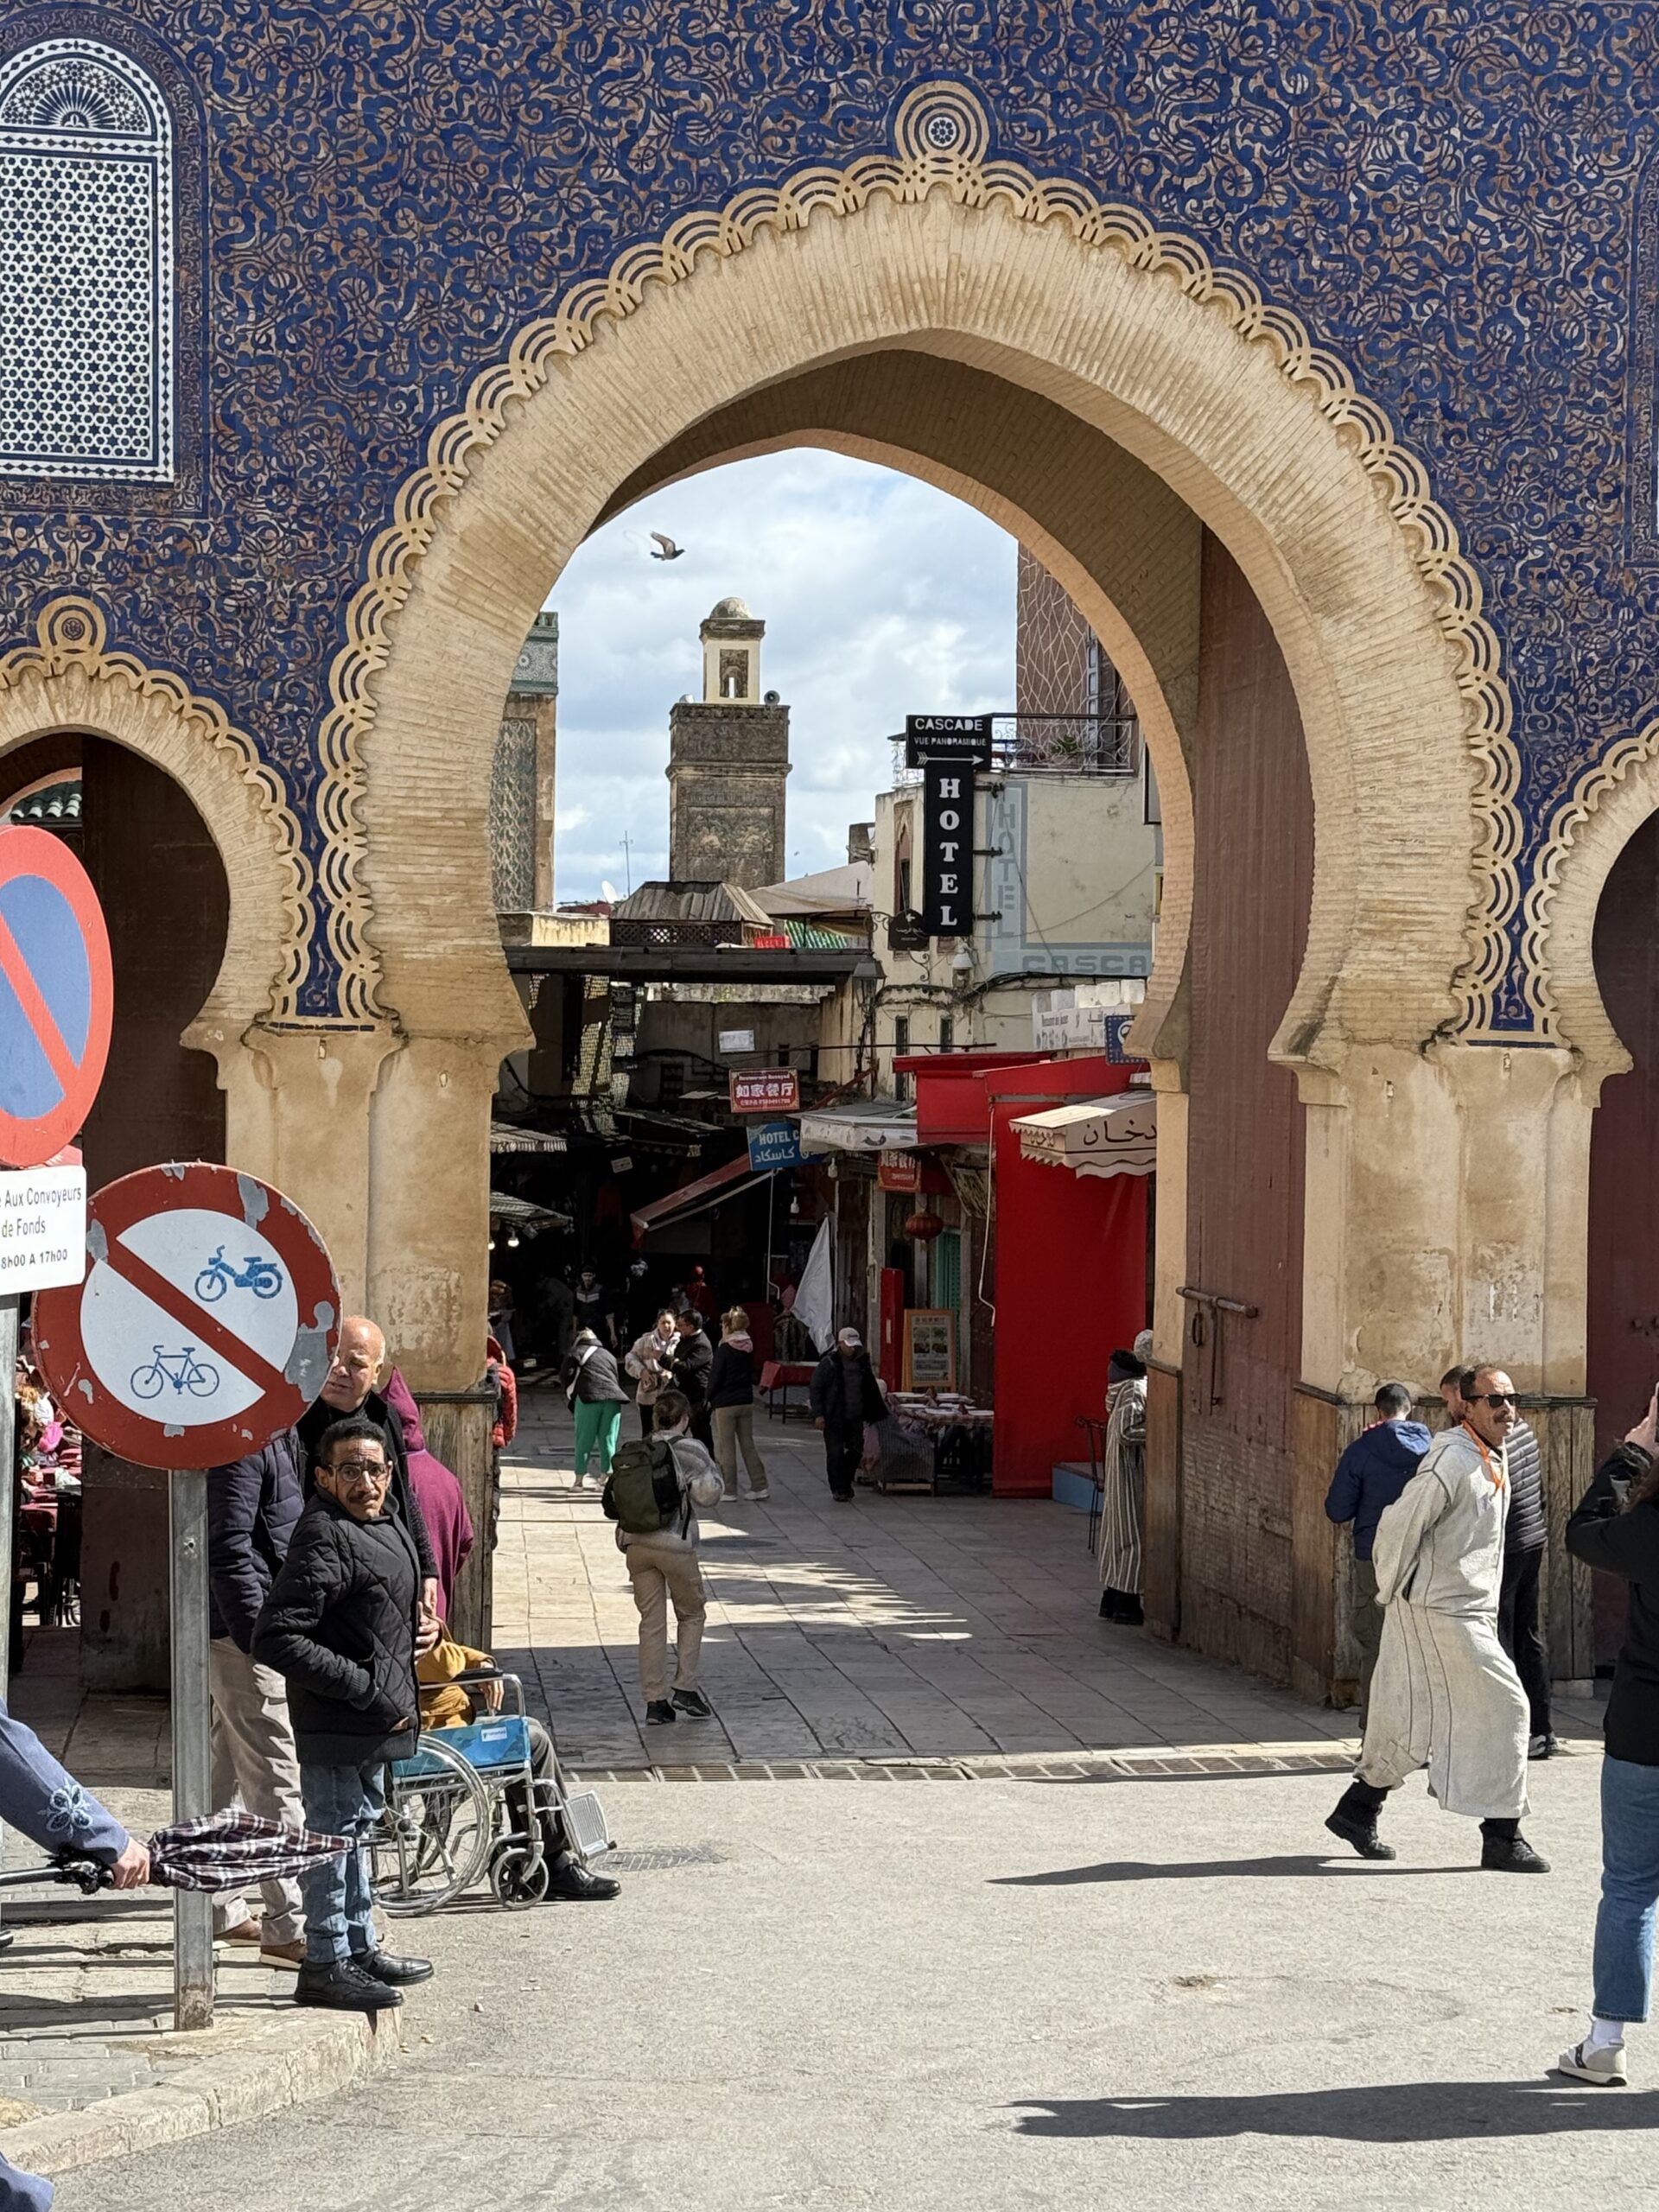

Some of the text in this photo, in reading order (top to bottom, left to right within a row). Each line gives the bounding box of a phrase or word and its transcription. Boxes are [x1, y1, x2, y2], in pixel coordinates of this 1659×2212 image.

[914, 717, 983, 732] CASCADE
[913, 736, 987, 747] VUE PANORAMIQUE
[938, 778, 961, 926] HOTEL
[997, 803, 1017, 938] HOTEL
[760, 1130, 791, 1146] HOTEL
[754, 1145, 795, 1163] كاسكاد
[4, 1190, 24, 1208] Aux
[26, 1187, 81, 1208] Convoyeurs
[2, 1216, 46, 1238] de Fonds
[1, 1248, 68, 1269] 8h00 A 17h00
